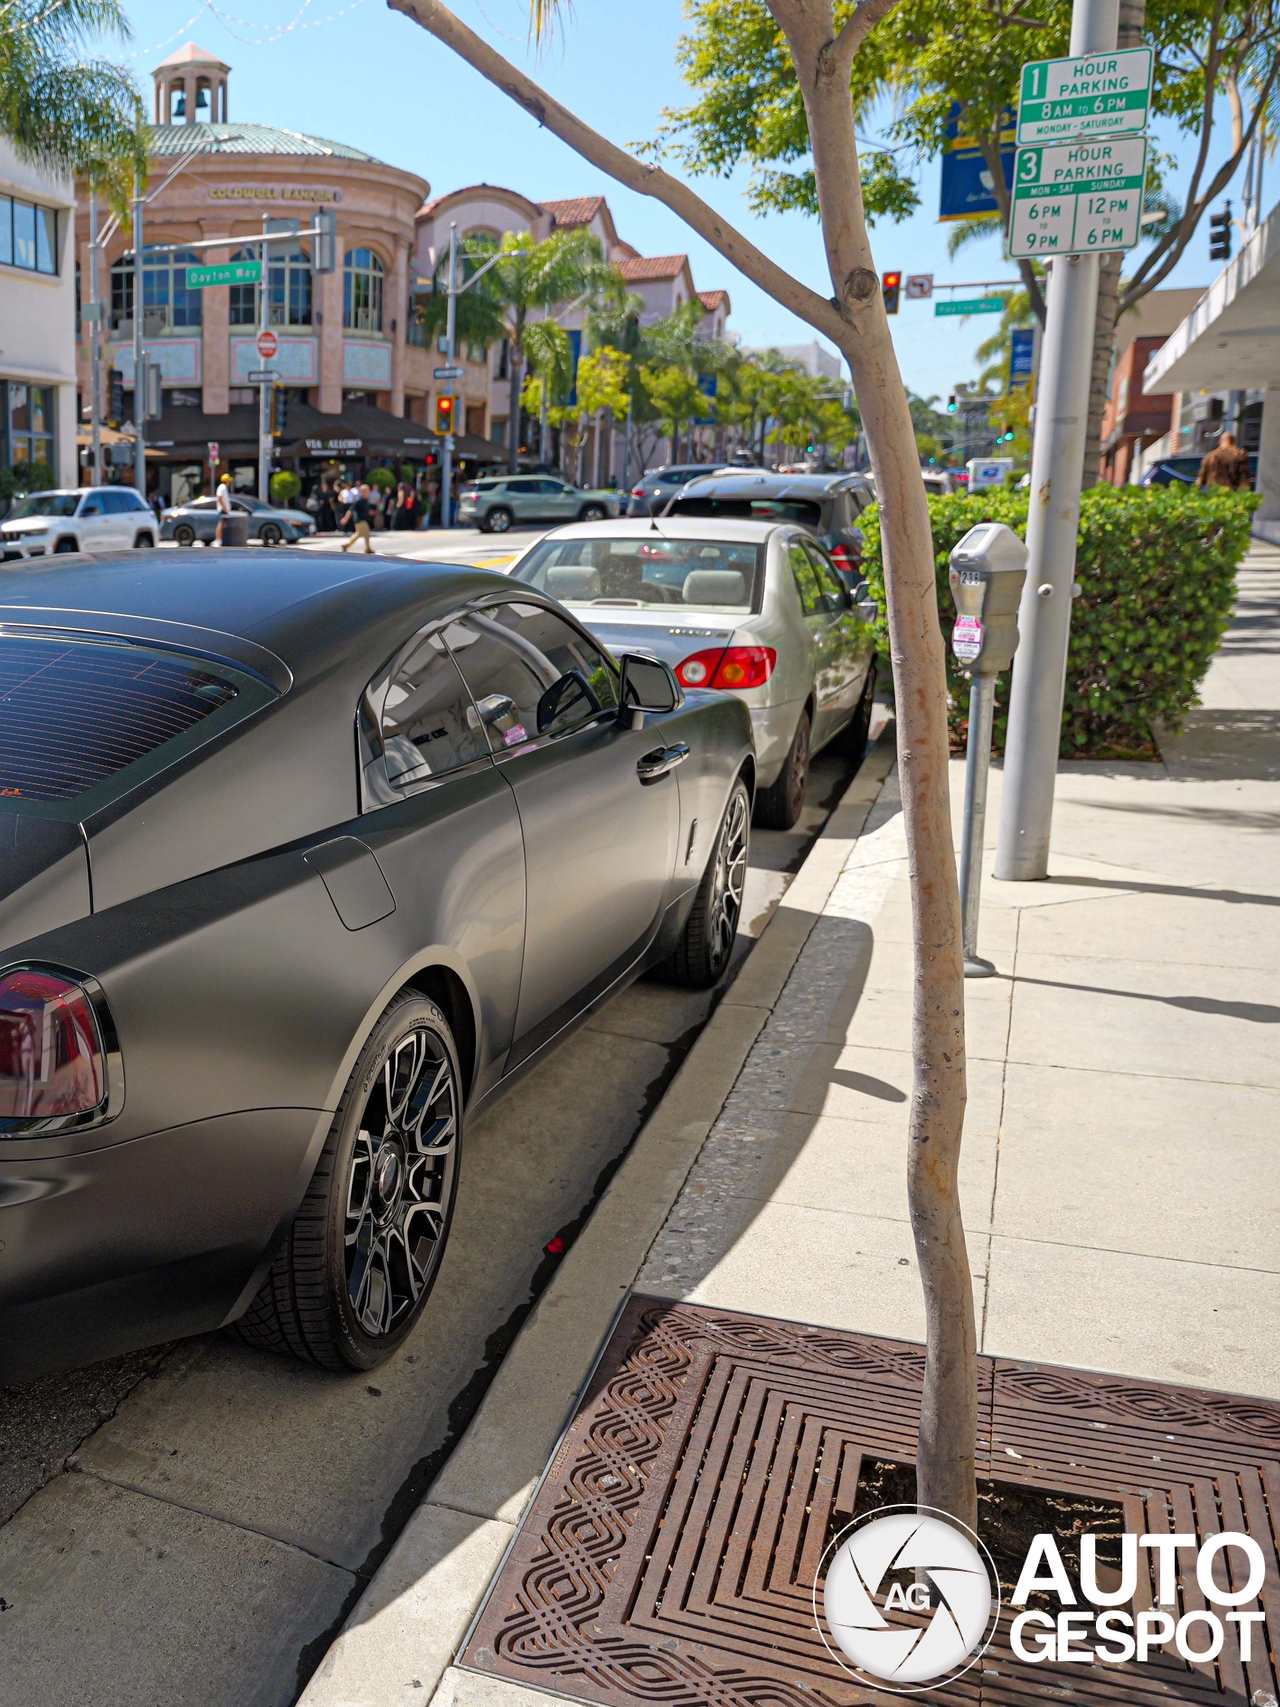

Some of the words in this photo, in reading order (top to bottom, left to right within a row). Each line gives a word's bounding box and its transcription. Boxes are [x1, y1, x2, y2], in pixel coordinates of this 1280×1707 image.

[1073, 60, 1118, 78] HOUR
[1032, 68, 1040, 96] 1
[1060, 76, 1129, 97] PARKING
[1079, 105, 1088, 114] TO
[1036, 123, 1071, 135] MONDAY
[1080, 117, 1124, 130] SATURDAY
[1068, 146, 1112, 163] HOUR
[1020, 152, 1037, 181] 3
[1054, 163, 1124, 182] PARKING
[1030, 186, 1050, 196] MON
[1059, 184, 1075, 194] SAT
[1091, 179, 1126, 191] SUNDAY
[1040, 222, 1048, 230] TO
[1102, 217, 1111, 225] TO
[191, 270, 231, 283] Dayton
[236, 268, 257, 278] Way
